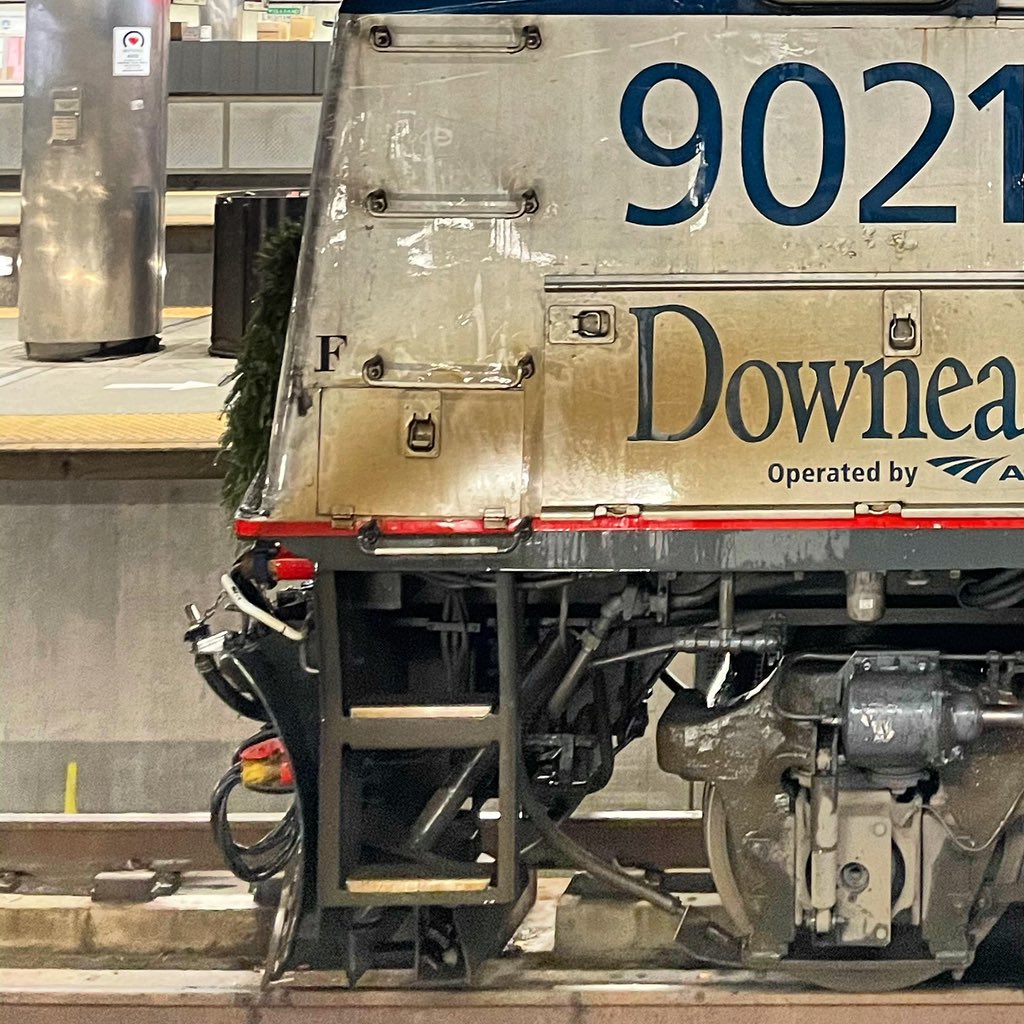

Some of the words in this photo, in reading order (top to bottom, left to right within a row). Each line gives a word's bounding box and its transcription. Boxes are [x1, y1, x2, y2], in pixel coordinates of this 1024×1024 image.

[314, 335, 347, 372] F
[768, 461, 880, 488] Operated
[889, 461, 918, 487] by
